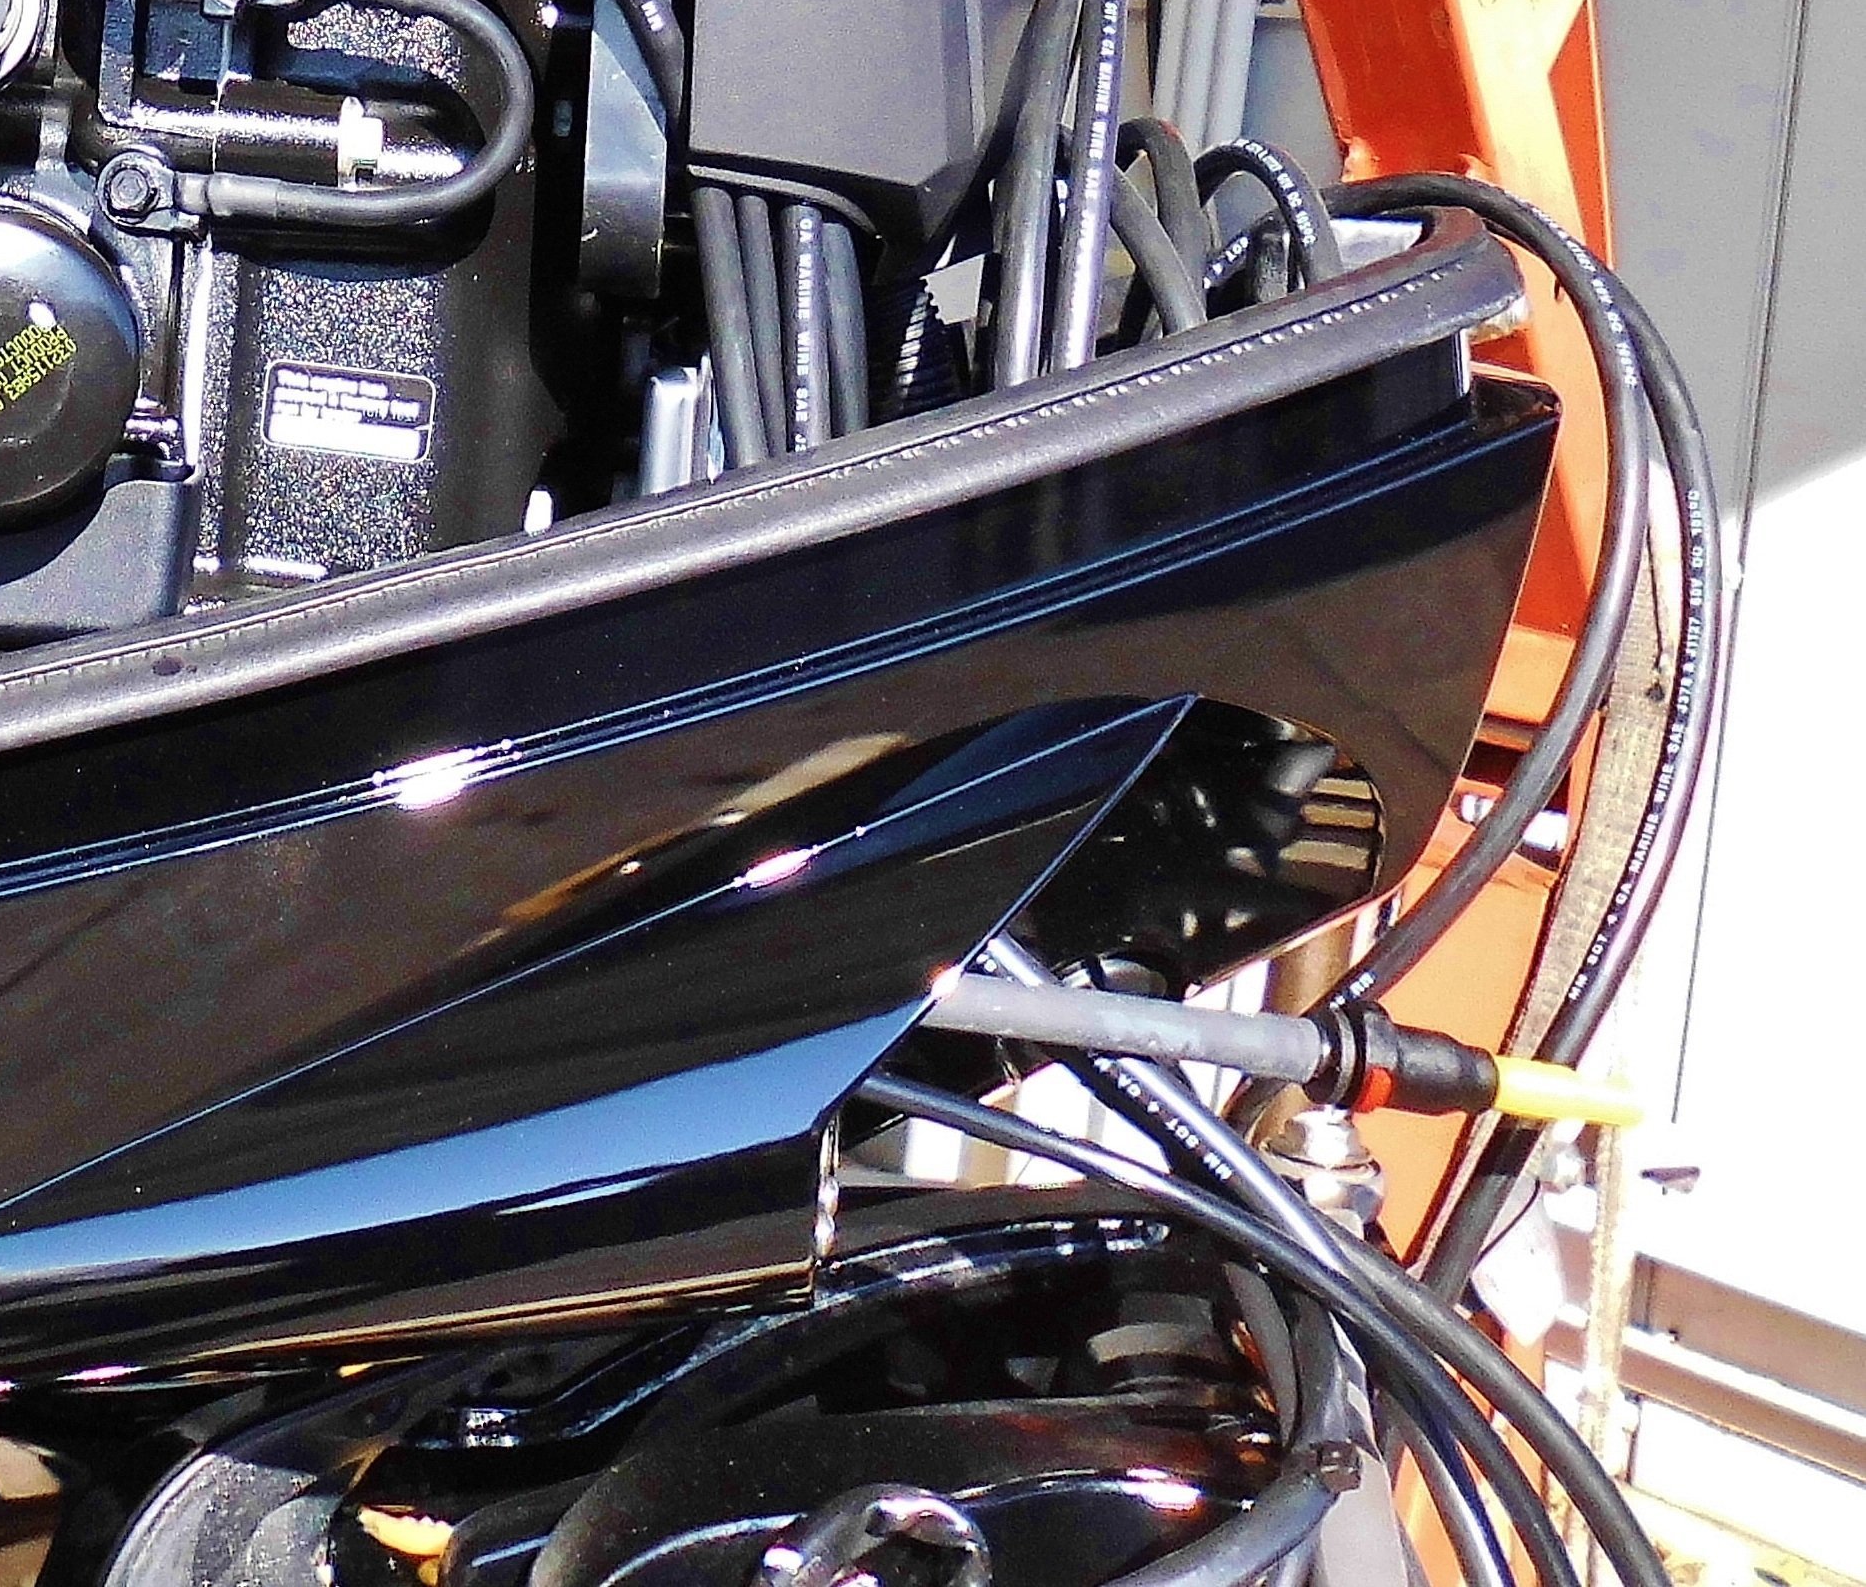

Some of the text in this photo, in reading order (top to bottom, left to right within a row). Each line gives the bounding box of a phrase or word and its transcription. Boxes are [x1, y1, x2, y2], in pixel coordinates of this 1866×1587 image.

[796, 253, 812, 320] MARINE
[10, 324, 69, 376] PRODUCT
[796, 330, 811, 376] WIRE
[795, 387, 809, 422] SAE
[1628, 812, 1662, 873] MARINE
[1653, 763, 1676, 803] WIRE
[1667, 722, 1685, 754] SAE
